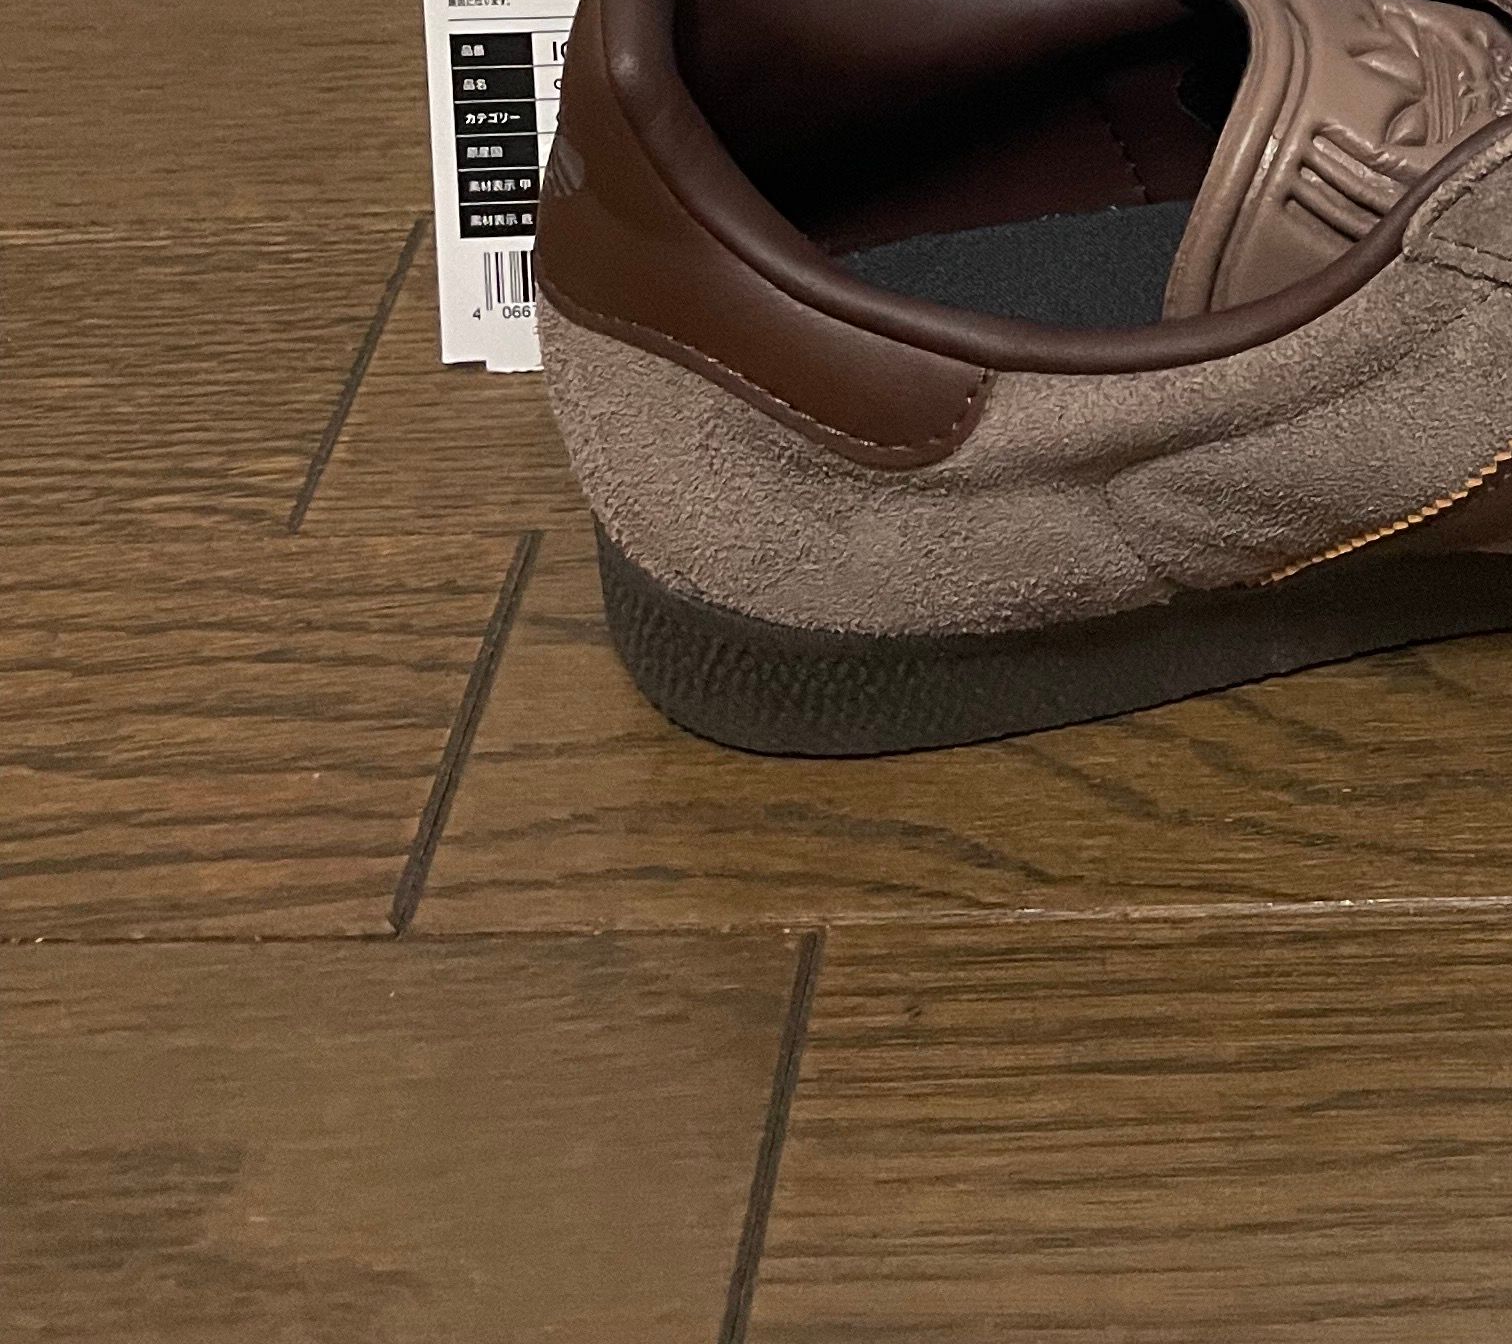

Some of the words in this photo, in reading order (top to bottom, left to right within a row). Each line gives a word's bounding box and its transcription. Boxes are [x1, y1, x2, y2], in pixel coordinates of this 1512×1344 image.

[465, 112, 521, 124] カテゴリー
[472, 307, 482, 321] 4
